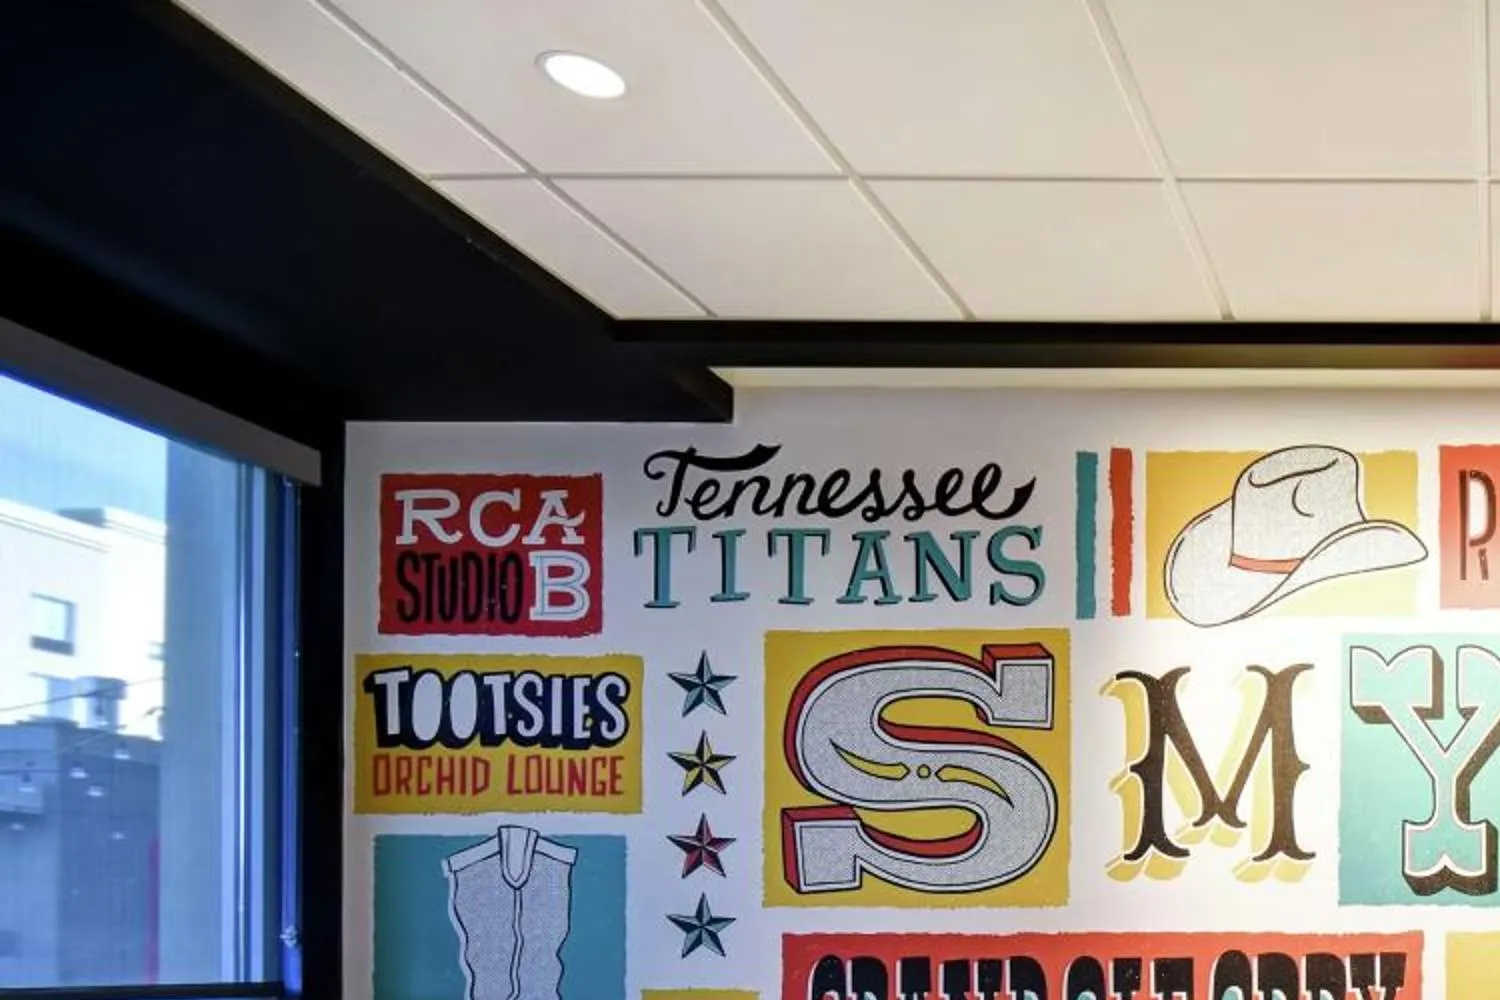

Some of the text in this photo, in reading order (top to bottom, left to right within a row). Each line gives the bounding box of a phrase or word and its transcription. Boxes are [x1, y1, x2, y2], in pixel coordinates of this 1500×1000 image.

[394, 487, 586, 547] RCA
[643, 444, 1036, 522] Tennessee
[395, 550, 591, 625] STUDIO B
[633, 524, 1048, 610] TITANS
[363, 665, 631, 750] TOOTSIES
[372, 753, 625, 798] ORCHID LOUNGE
